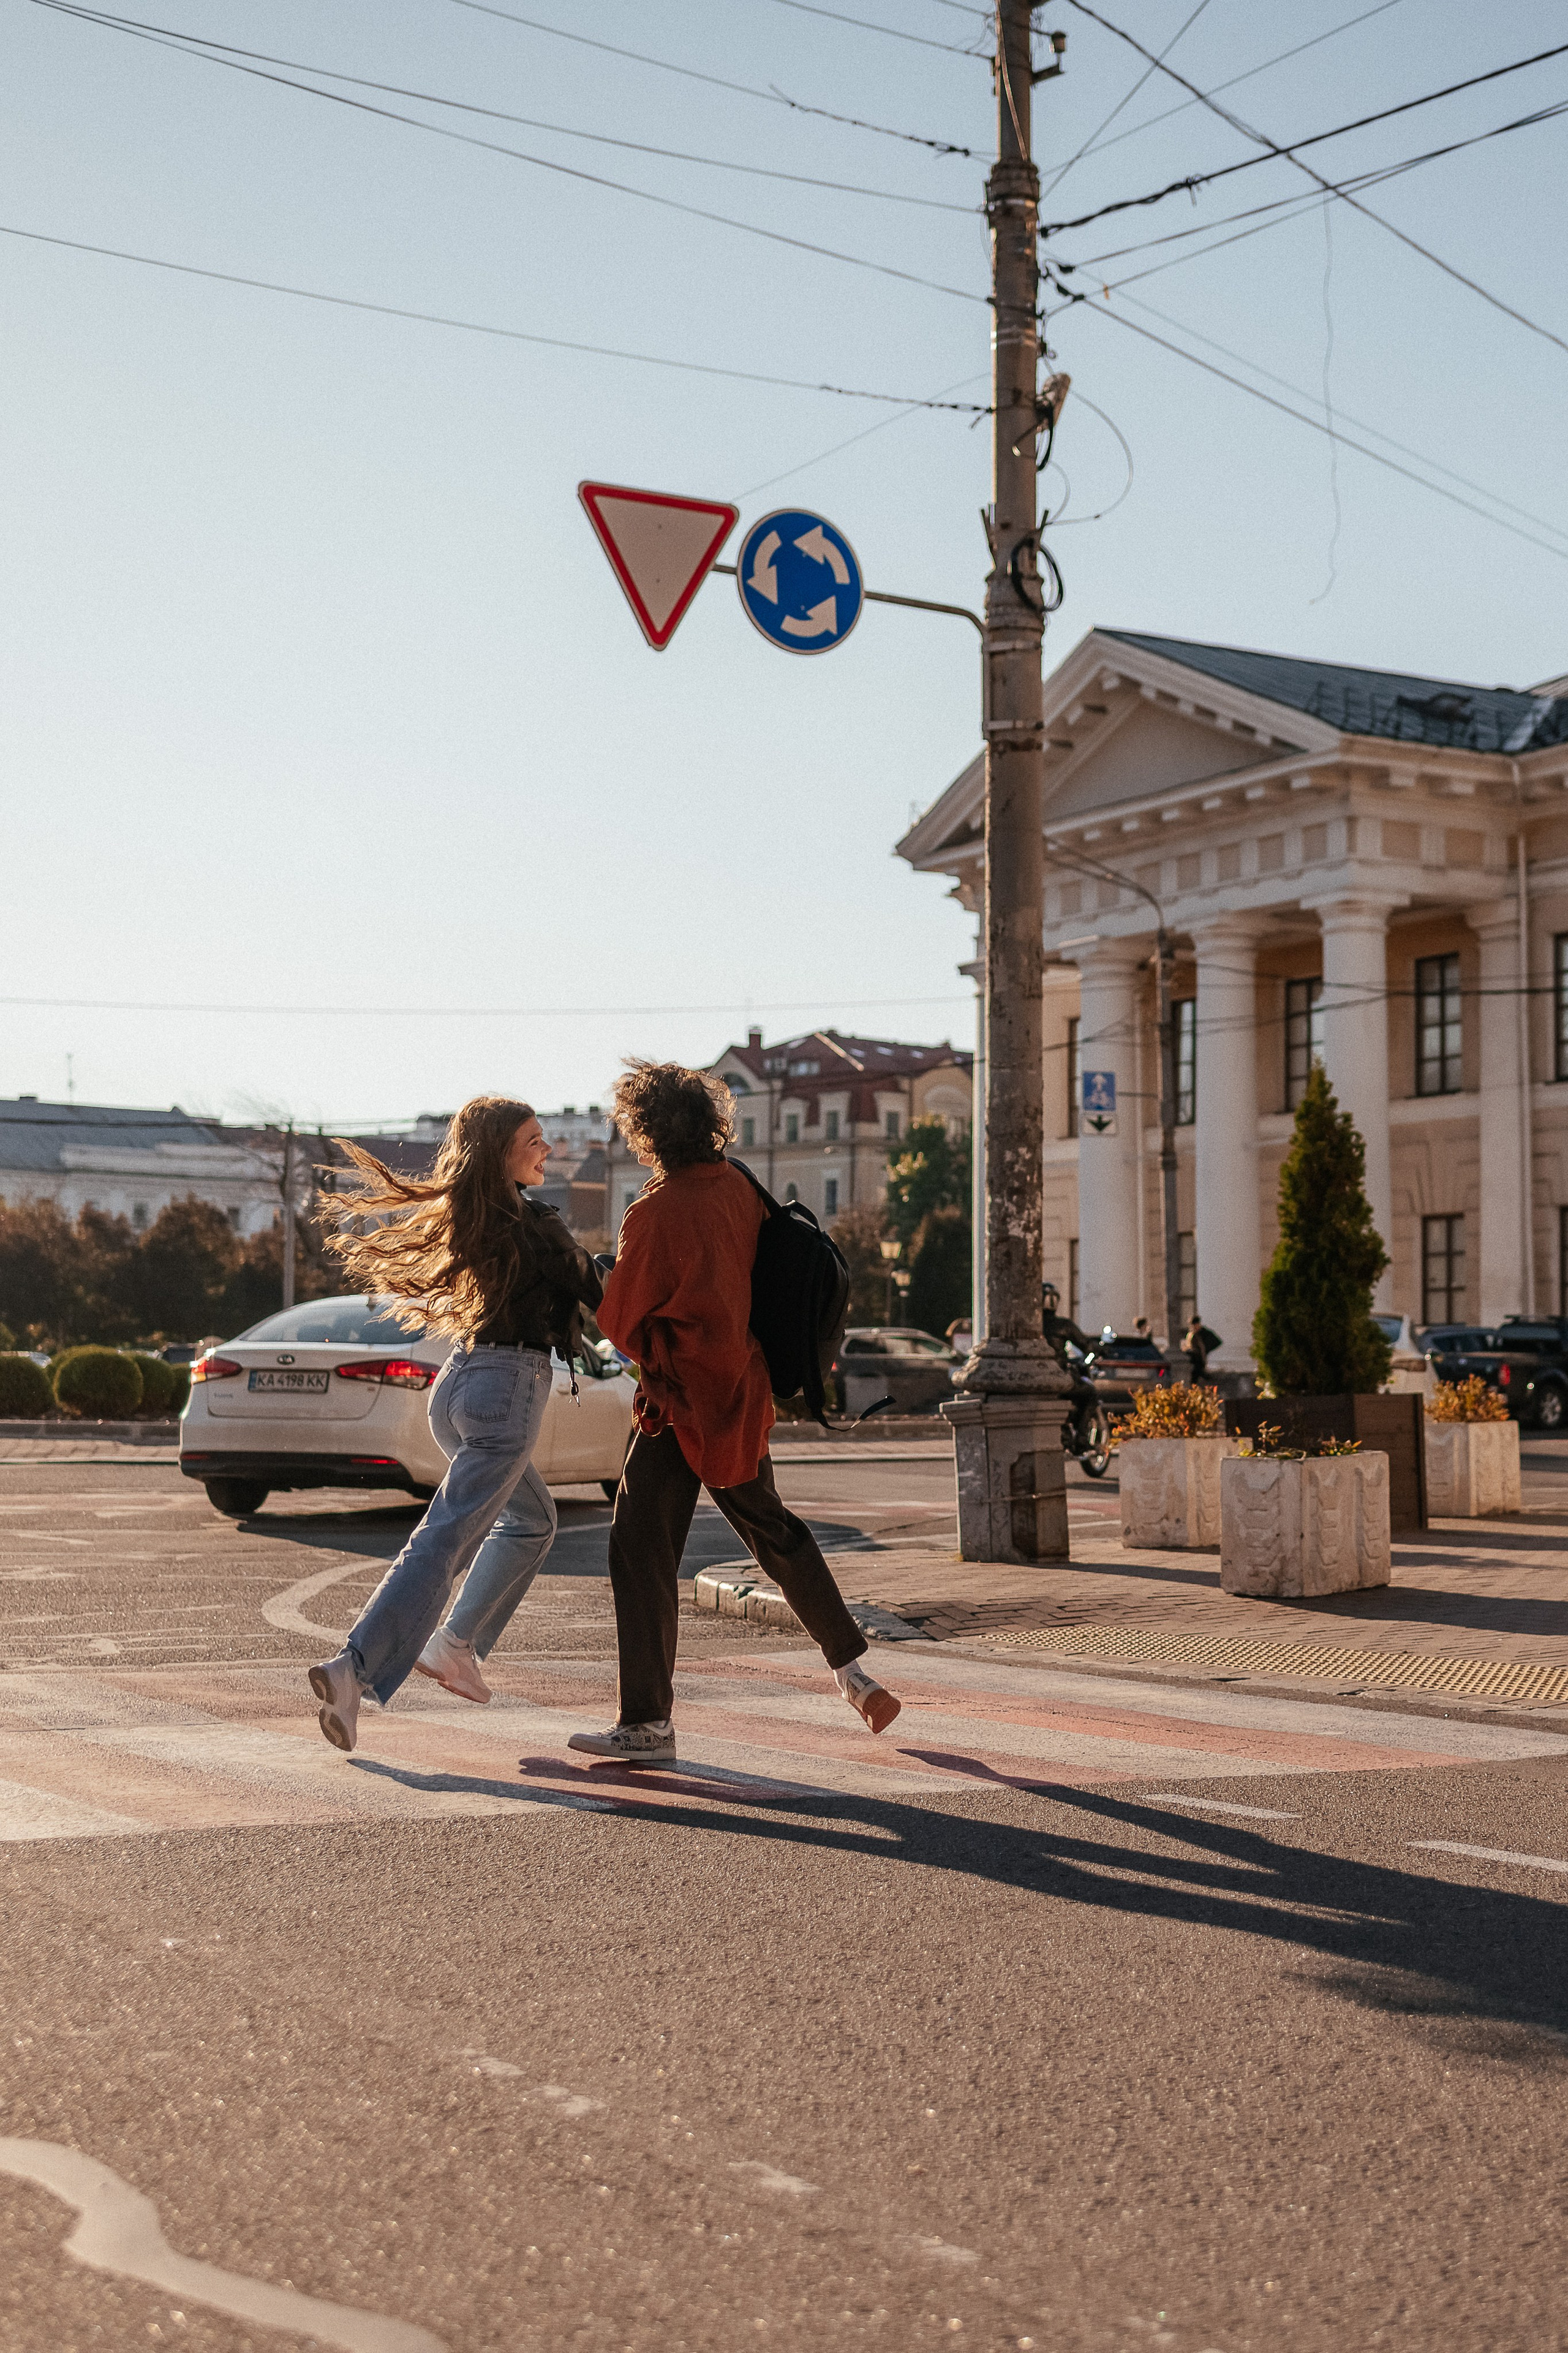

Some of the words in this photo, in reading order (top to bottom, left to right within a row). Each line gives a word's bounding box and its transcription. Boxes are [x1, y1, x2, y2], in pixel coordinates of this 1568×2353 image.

[258, 1373, 274, 1386] KA
[277, 1373, 304, 1387] 4198
[307, 1373, 325, 1388] KK
